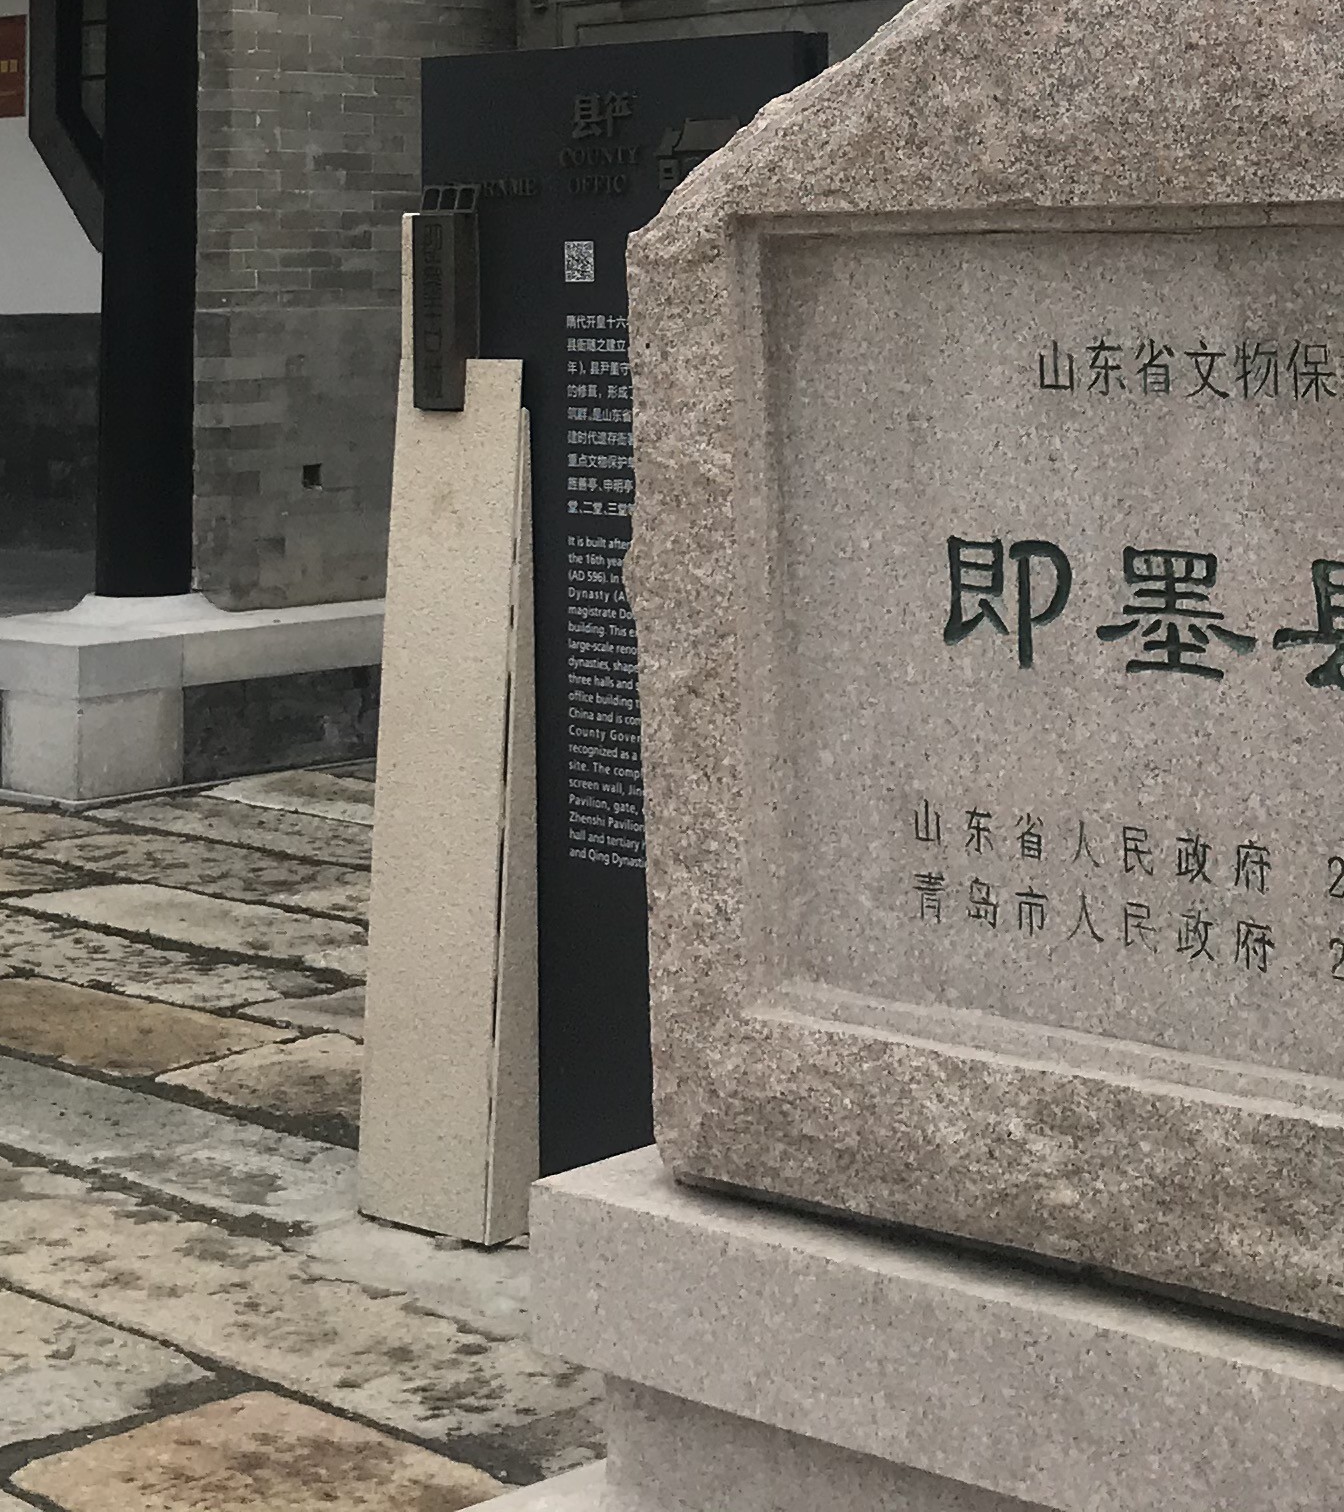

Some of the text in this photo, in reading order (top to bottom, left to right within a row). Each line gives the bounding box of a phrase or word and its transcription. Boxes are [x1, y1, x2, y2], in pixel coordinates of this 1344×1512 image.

[566, 314, 629, 330] 隋代开皇十六
[577, 536, 584, 547] is
[586, 536, 607, 549] built
[568, 553, 584, 564] the
[585, 553, 605, 566] 16th
[568, 570, 585, 582] (AD
[568, 587, 610, 603] Dynasty
[568, 605, 616, 619] magistrate
[568, 621, 607, 638] building.
[609, 624, 627, 637] This
[568, 638, 614, 653] large-scale
[568, 673, 633, 690] three halls and
[568, 690, 633, 710] office building
[569, 707, 594, 720] China
[596, 711, 613, 723] and
[615, 714, 623, 724] is
[569, 725, 606, 742] County
[568, 743, 638, 761] recognized as a
[568, 759, 590, 772] site.
[593, 761, 610, 775] The
[569, 778, 599, 791] screen
[602, 781, 625, 797] wall,
[569, 793, 638, 816] Pavilion, gate,
[569, 810, 606, 826] Zhenshi
[569, 828, 640, 852] hall and tertiary
[912, 799, 1274, 897] 山东省人民政府
[569, 847, 586, 859] and
[588, 848, 610, 866] Qing
[912, 873, 1276, 975] 青岛市人民政府
